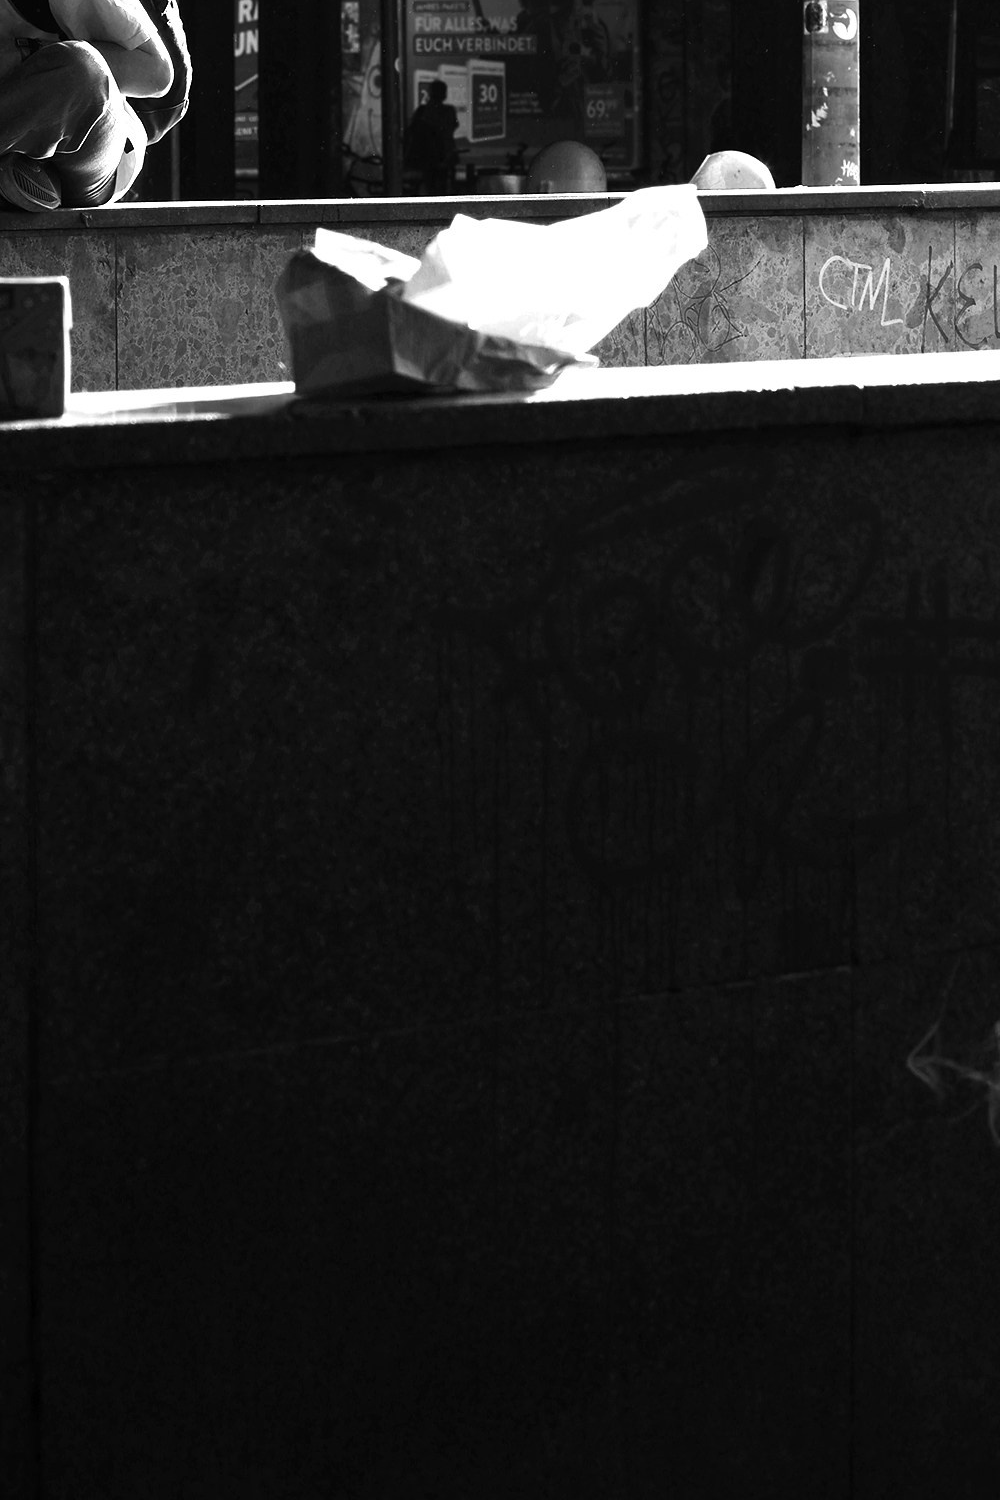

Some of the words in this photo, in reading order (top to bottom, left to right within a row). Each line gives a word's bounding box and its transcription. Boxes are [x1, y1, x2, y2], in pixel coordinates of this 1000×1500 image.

[415, 14, 442, 32] FÜR
[490, 16, 518, 32] WAS
[415, 37, 453, 53] EUCH
[479, 84, 498, 103] 30
